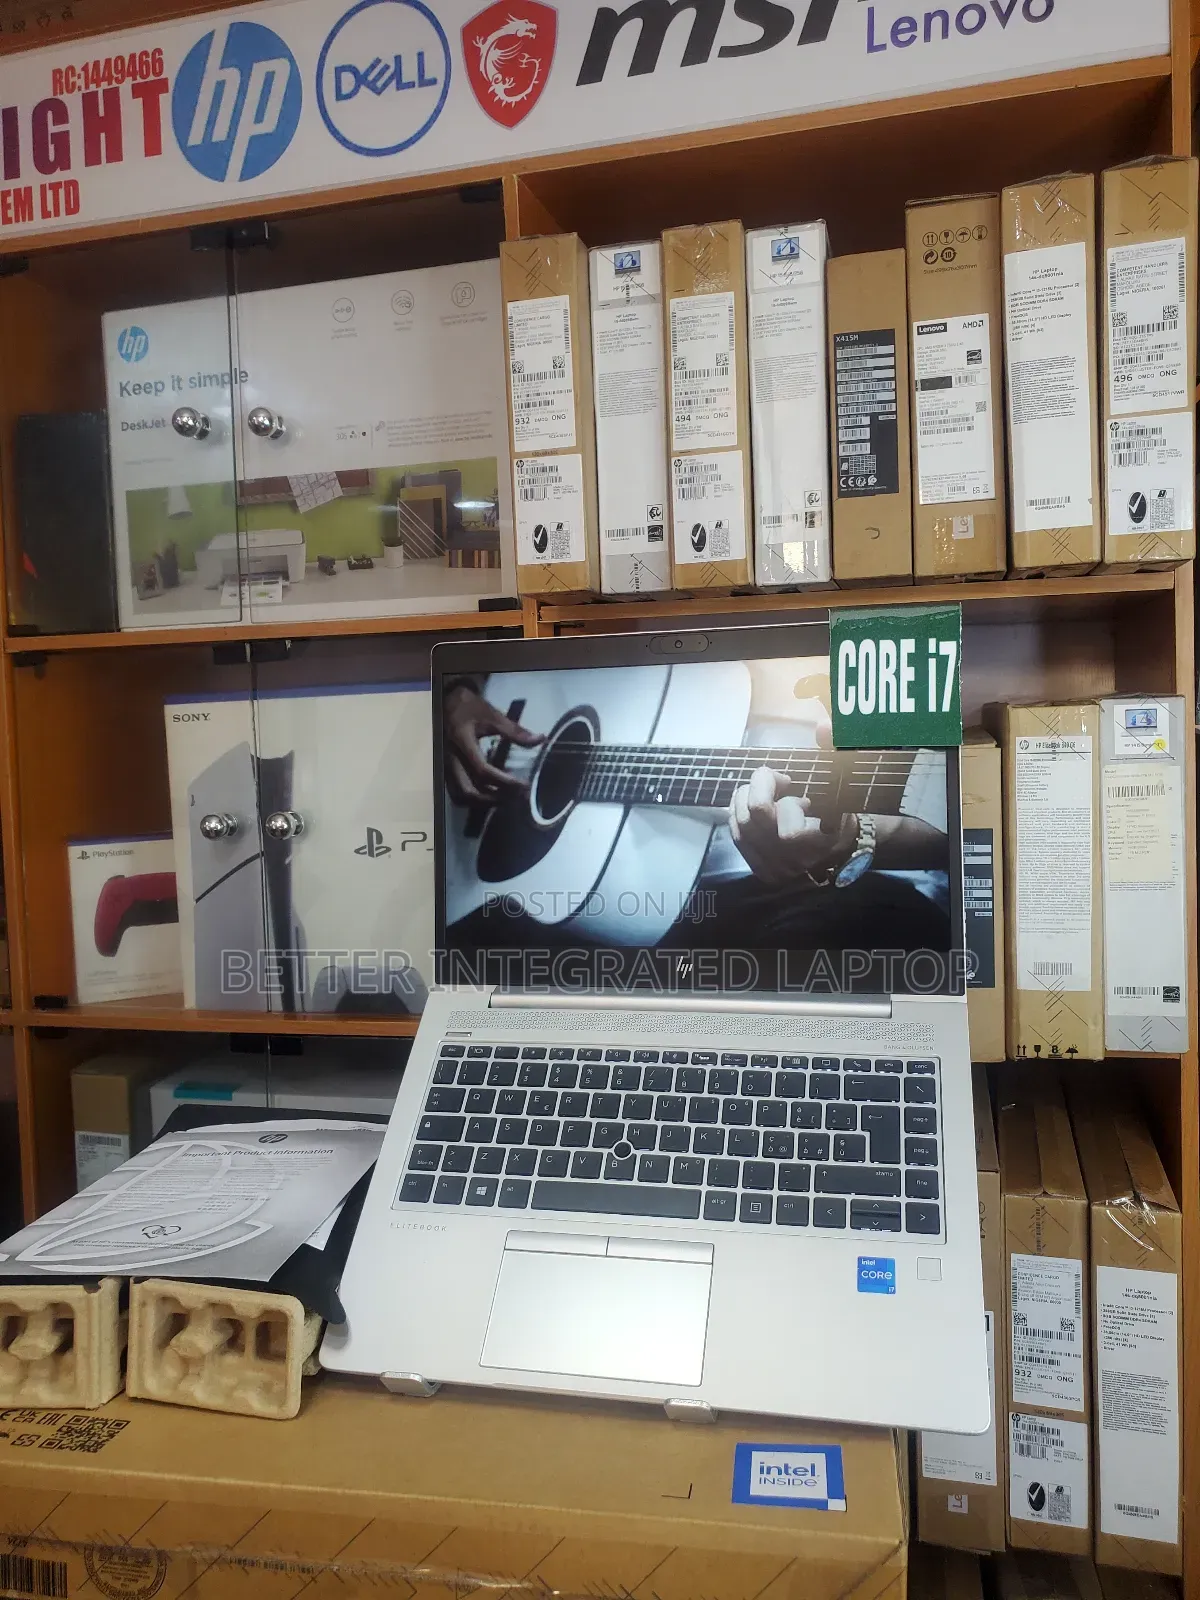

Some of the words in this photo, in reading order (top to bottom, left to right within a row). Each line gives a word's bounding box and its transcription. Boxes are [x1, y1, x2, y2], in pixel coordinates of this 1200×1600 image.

[866, 0, 1054, 54] Lenovo
[52, 48, 164, 97] RC:1449466
[334, 56, 437, 102] DELL
[187, 24, 290, 182] hp
[40, 179, 80, 219] LTD
[835, 334, 859, 342] X415M
[119, 380, 165, 397] Keep
[171, 374, 183, 391] it
[188, 367, 249, 390] simple
[1114, 374, 1133, 383] 496
[1160, 369, 1177, 377] ONG
[121, 417, 167, 431] DeskJet
[515, 417, 530, 425] 932
[838, 639, 915, 715] CORE
[928, 638, 957, 712] i7
[172, 712, 211, 722] SONY
[92, 849, 134, 858] PlayStation
[1014, 1369, 1032, 1378] 932
[1056, 1375, 1074, 1383] ONG
[759, 1462, 817, 1477] intel
